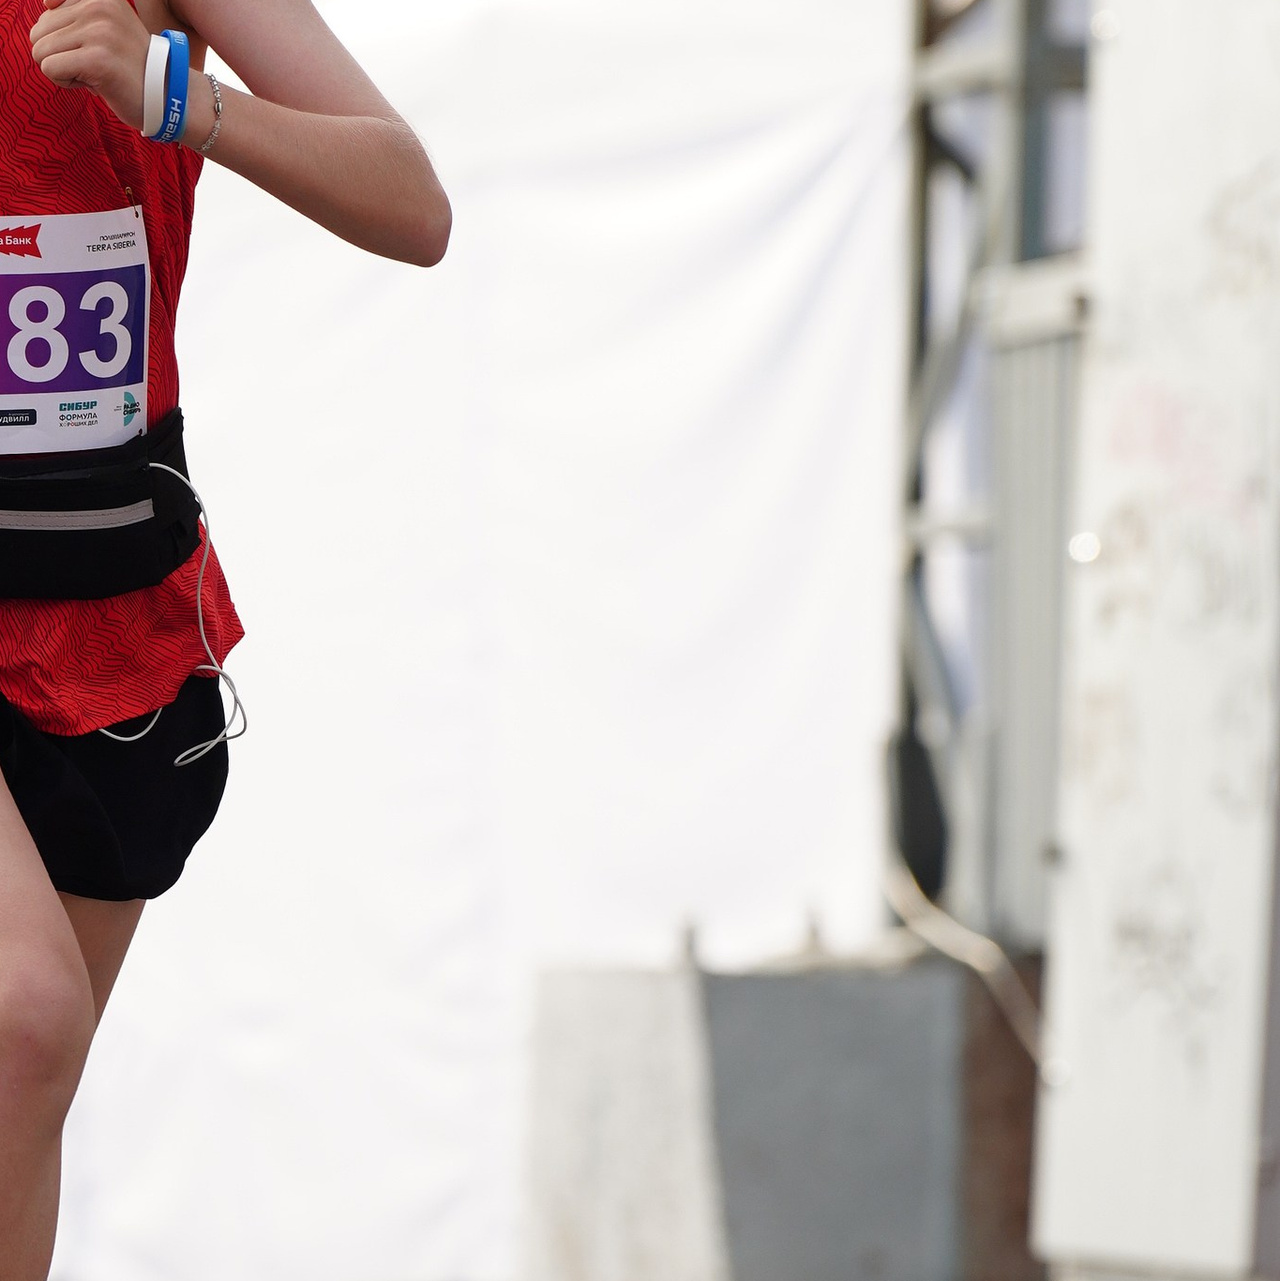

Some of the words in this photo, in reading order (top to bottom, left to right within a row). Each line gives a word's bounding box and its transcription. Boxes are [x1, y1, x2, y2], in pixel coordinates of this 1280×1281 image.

[5, 235, 32, 246] Банк
[86, 243, 112, 252] TERRA
[113, 240, 136, 250] SIBERIA
[59, 401, 98, 412] СИБУР
[59, 412, 98, 421] ФОРМУЛА
